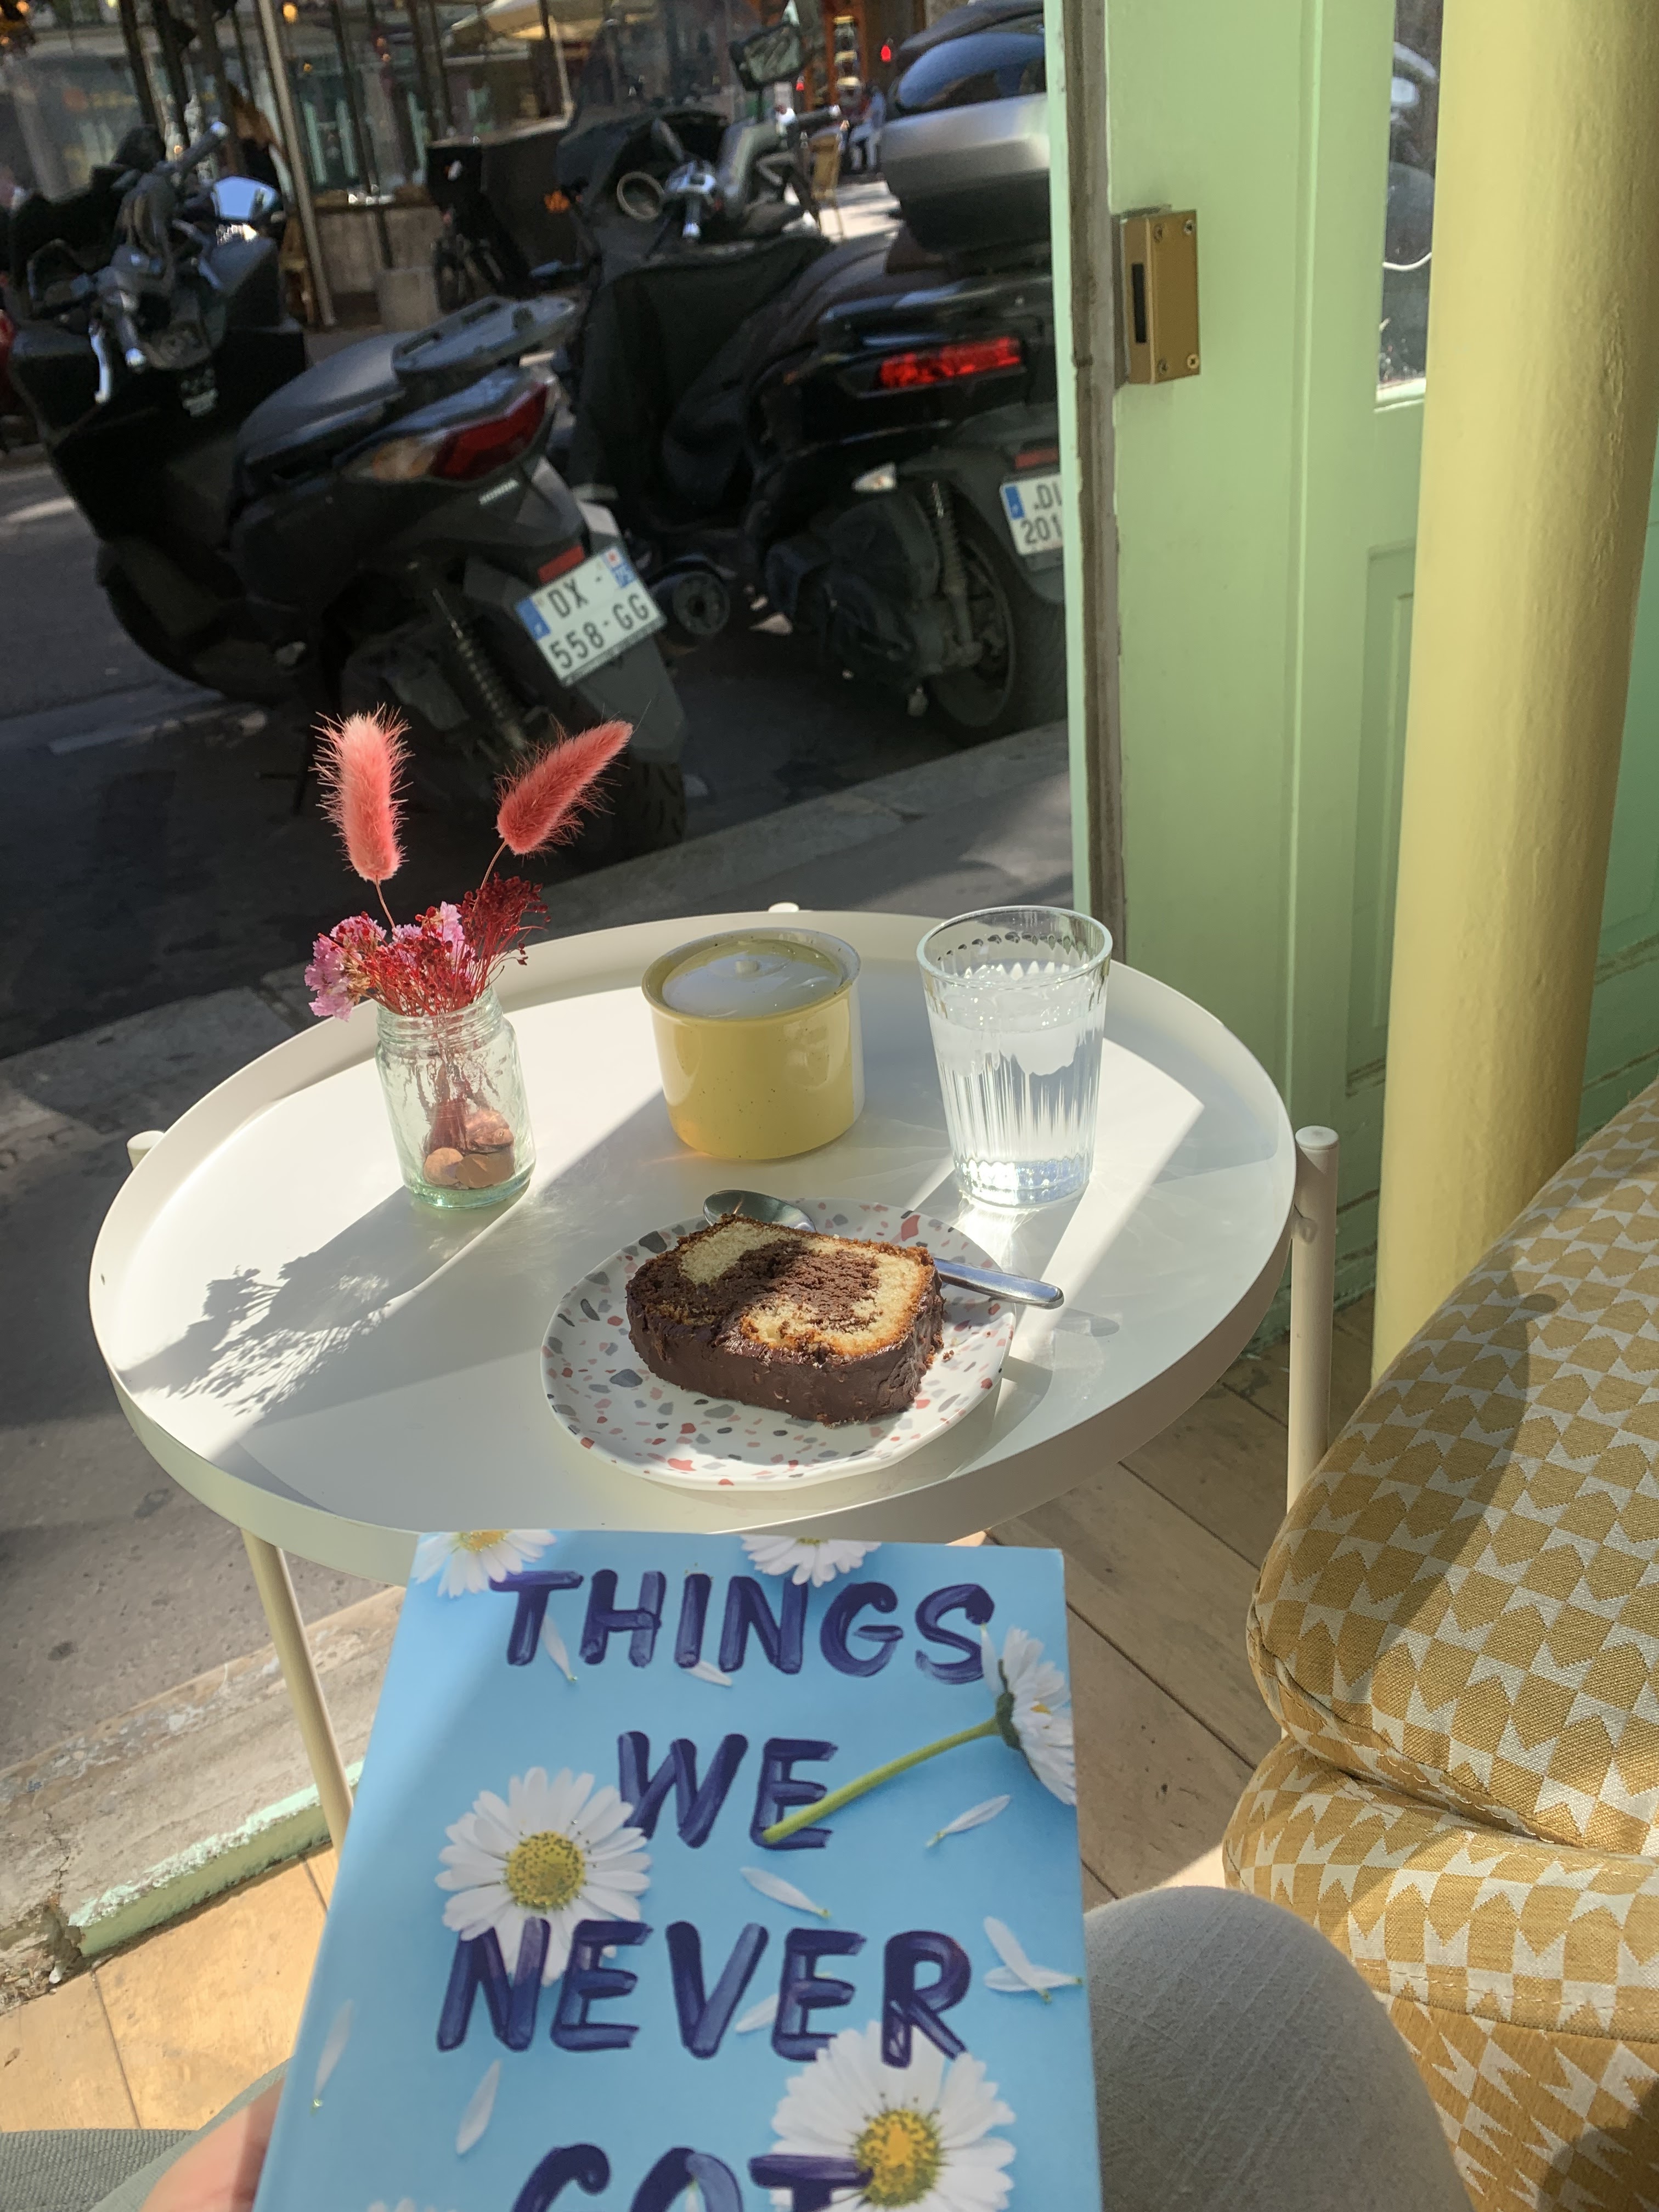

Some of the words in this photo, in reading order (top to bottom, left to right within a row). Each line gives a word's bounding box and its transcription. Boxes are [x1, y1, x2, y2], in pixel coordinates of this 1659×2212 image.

[489, 1568, 995, 1685] THINGS
[618, 1731, 838, 1850] WE
[436, 1917, 971, 2068] NEVER
